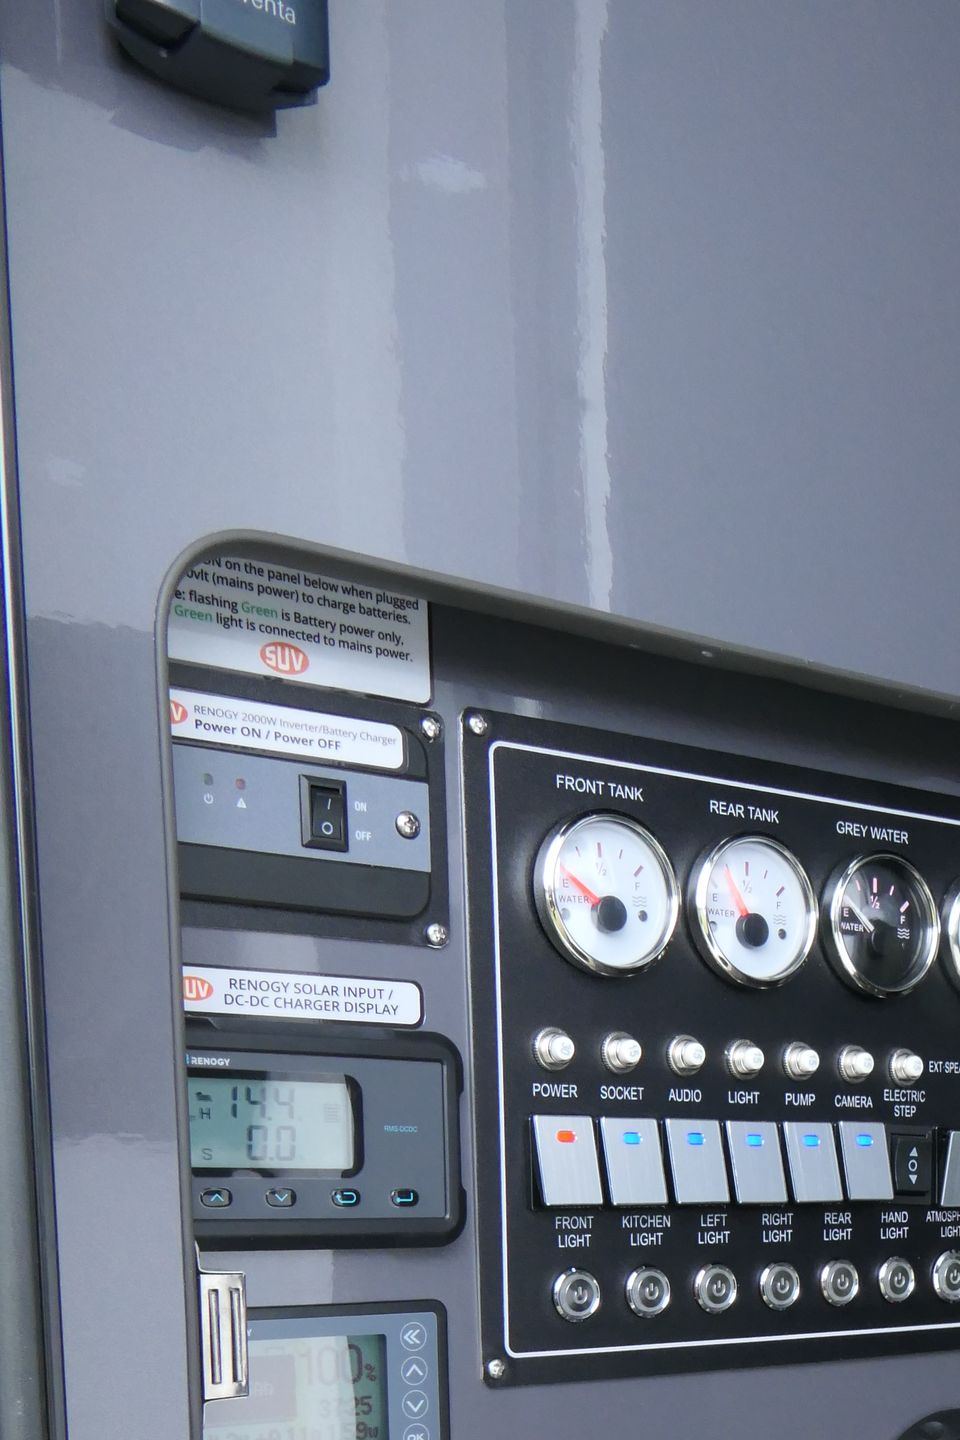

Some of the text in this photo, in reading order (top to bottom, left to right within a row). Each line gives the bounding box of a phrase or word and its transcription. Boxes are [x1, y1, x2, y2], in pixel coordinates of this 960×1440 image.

[225, 560, 240, 572] on
[244, 562, 265, 577] the
[267, 568, 300, 586] panel
[304, 574, 339, 593] below
[341, 584, 373, 600] when
[376, 591, 419, 611] plugged
[212, 571, 254, 592] (mains
[257, 584, 299, 603] power)
[302, 591, 314, 604] to
[317, 595, 356, 615] charge
[359, 603, 411, 625] batteries.
[189, 590, 239, 615] flashing
[241, 601, 278, 619] Green
[281, 609, 291, 622] is
[293, 611, 336, 633] Battery
[340, 623, 375, 640] power
[174, 604, 414, 663] Green light is connected to mains power.
[262, 645, 306, 674] SUV
[193, 704, 239, 720] RENOGY
[242, 712, 277, 727] 2000W
[279, 718, 358, 740] Inverter/Battery
[360, 731, 397, 747] Charger
[195, 719, 342, 751] Power ON / Power OFF
[556, 774, 644, 802] FRONT TANK
[354, 800, 367, 812] ON
[709, 799, 780, 824] REAR TANK
[354, 830, 372, 841] OFF
[836, 821, 909, 845] GREY WATER
[558, 895, 590, 905] WATER
[708, 908, 736, 919] WATER
[843, 907, 850, 918] E
[900, 915, 907, 925] F
[228, 977, 290, 993] RENOGY
[293, 982, 339, 997] SOLAR
[343, 986, 384, 1000] INPUT
[388, 989, 394, 1001] /
[224, 994, 399, 1016] DC-DC CHARGER DISPLAY
[190, 1056, 231, 1067] RENOGY
[532, 1083, 578, 1098] POWER
[600, 1085, 644, 1101] SOCKET
[668, 1088, 702, 1103] AUDIO
[883, 1089, 926, 1103] ELECTRIC
[728, 1091, 760, 1105] LIGHT
[785, 1093, 816, 1106] PUMP
[834, 1095, 873, 1109] CAMERA
[894, 1105, 917, 1118] STEP
[555, 1215, 594, 1230] FRONT
[622, 1215, 671, 1229] KITCHEN
[700, 1213, 728, 1227] LEFT
[762, 1212, 794, 1226] RIGHT
[824, 1212, 852, 1224] REAR
[881, 1211, 909, 1223] HAND
[630, 1232, 664, 1246] LIGHT
[698, 1231, 731, 1245] LIGHT
[762, 1229, 793, 1243] LIGHT
[823, 1228, 853, 1241] LIGHT
[880, 1226, 909, 1239] LIGHT
[558, 1234, 592, 1248] LIGHT
